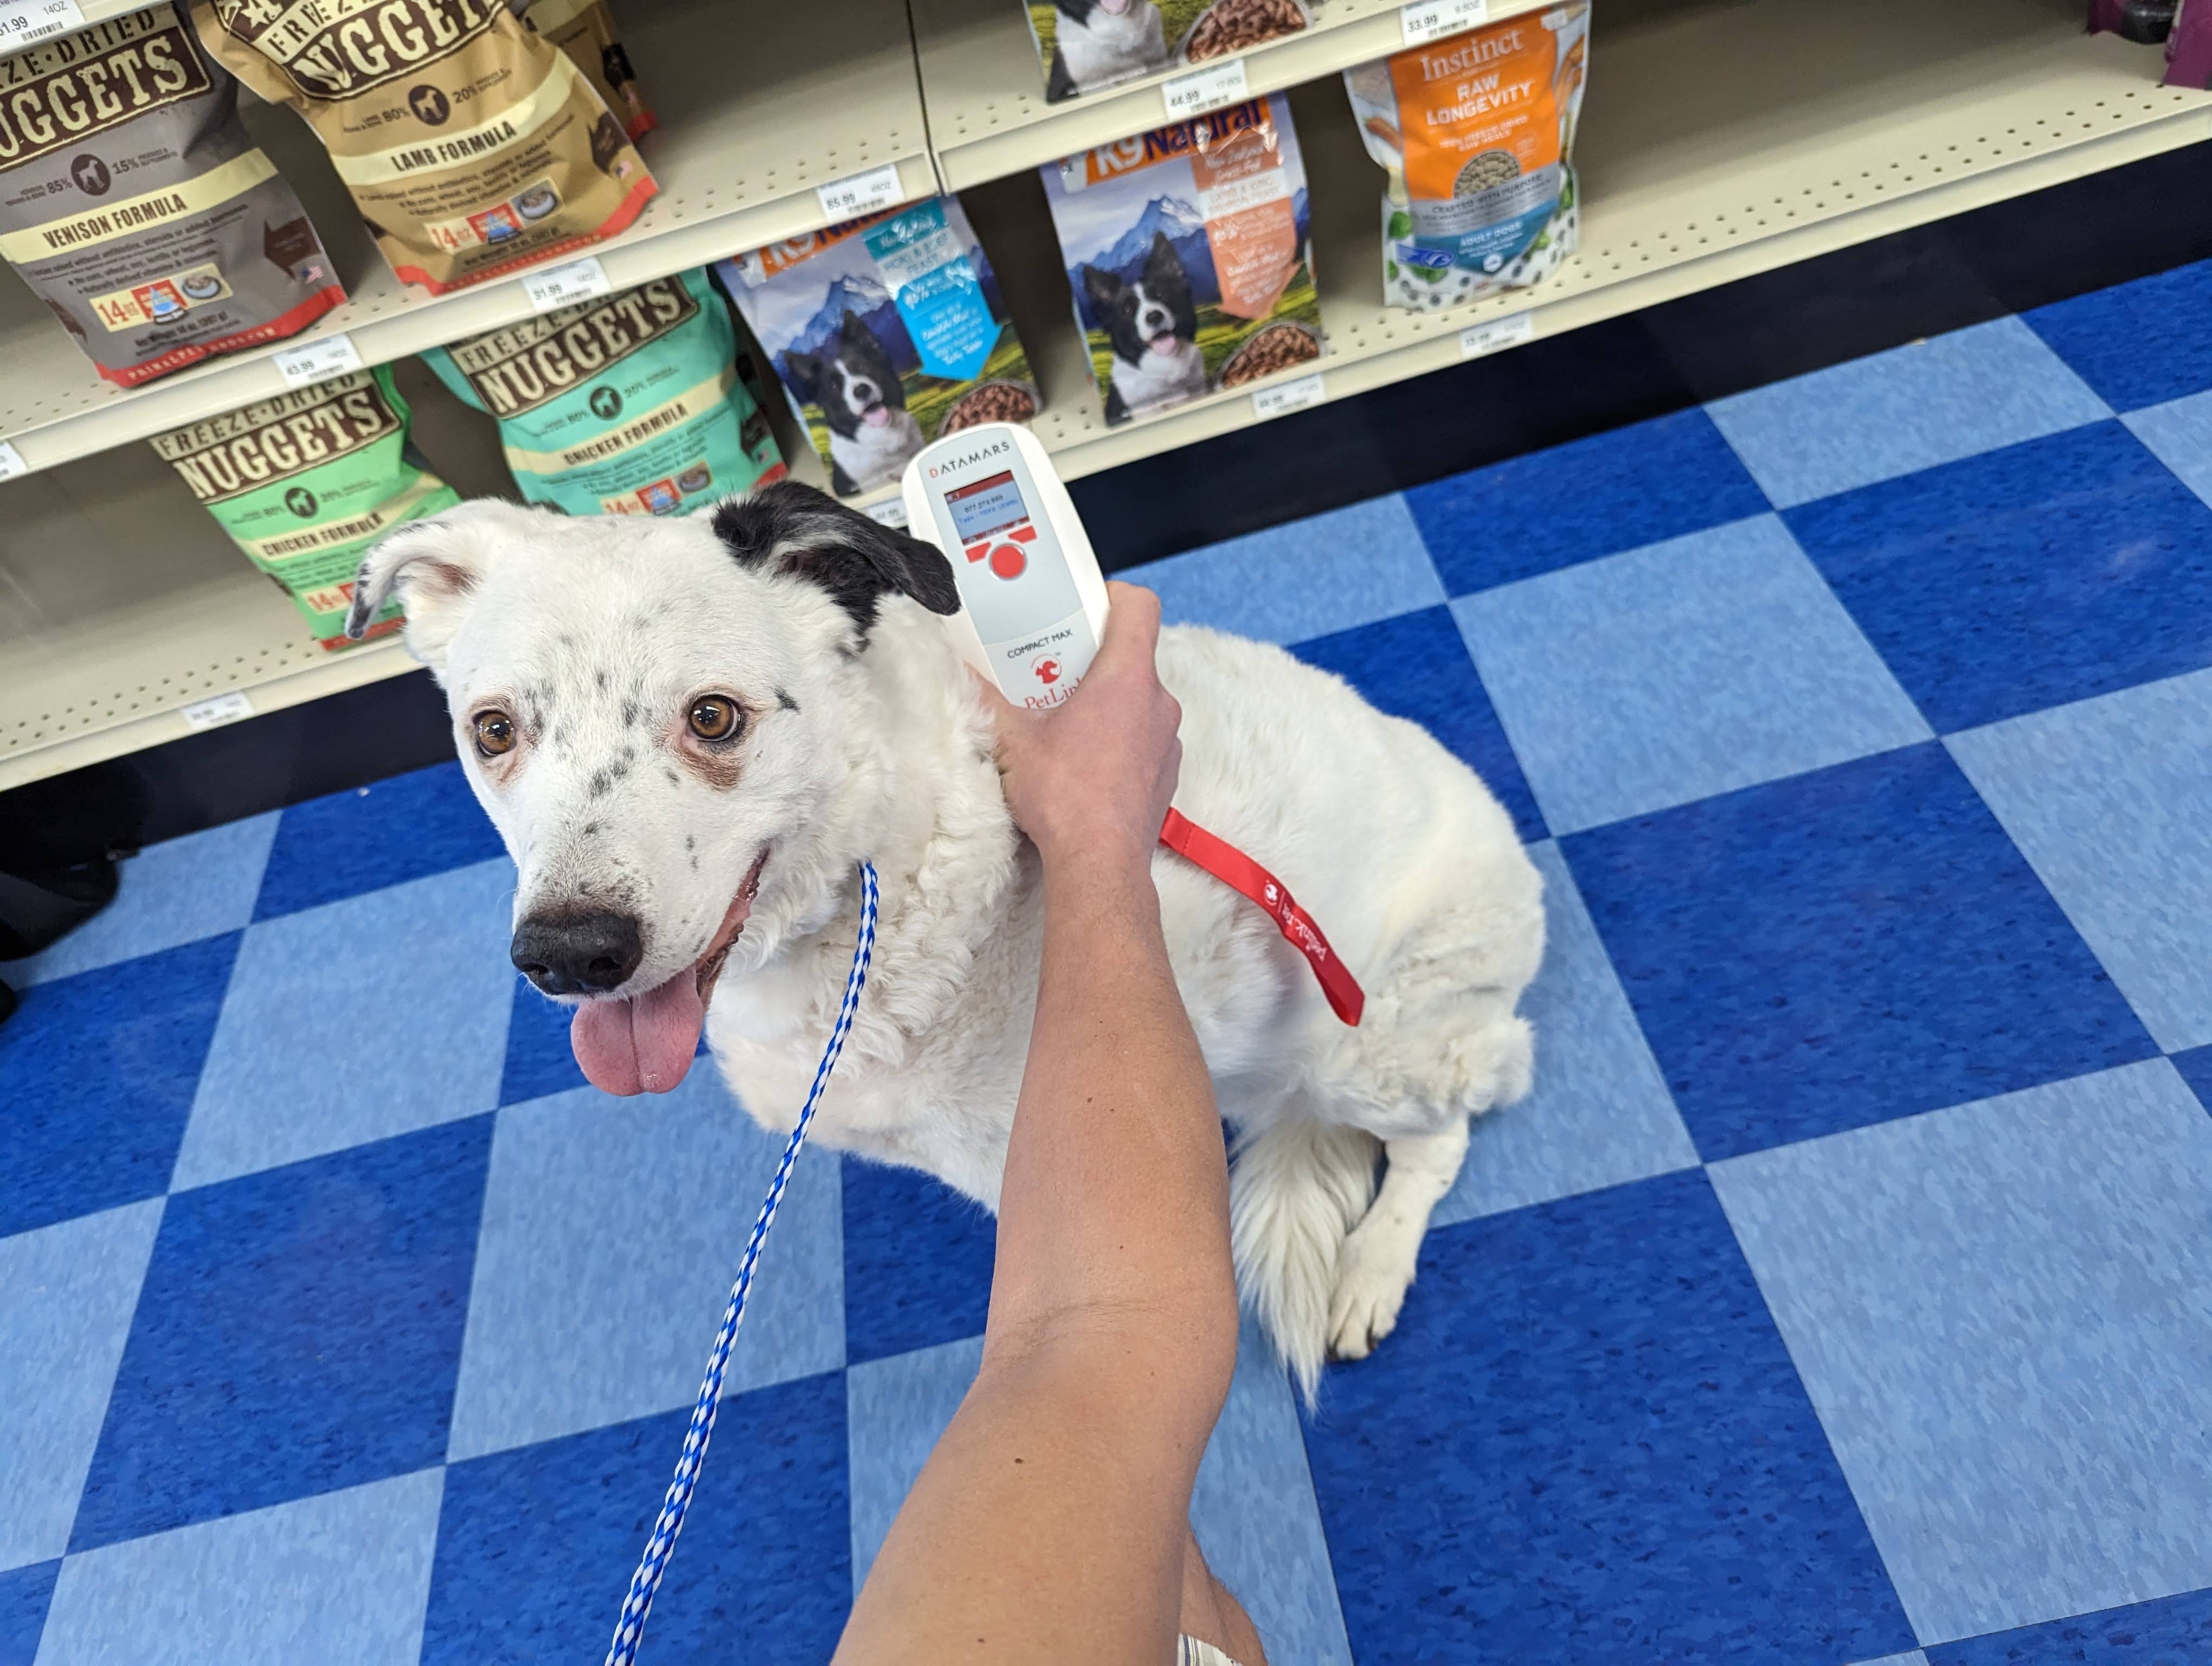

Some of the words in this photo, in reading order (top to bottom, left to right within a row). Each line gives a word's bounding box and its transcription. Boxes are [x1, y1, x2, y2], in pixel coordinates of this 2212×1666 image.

[1420, 28, 1525, 82] Instinct
[1425, 78, 1536, 126] LONGEVITY
[1456, 71, 1500, 101] RAW
[390, 147, 438, 172] LAMB
[436, 120, 517, 162] FORMULA
[42, 215, 113, 249] VENISON
[111, 193, 188, 229] FORMULA
[432, 227, 460, 248] 14
[99, 300, 130, 325] 14
[477, 278, 681, 414] NUGGETS
[173, 390, 383, 500] NUGGETS
[564, 434, 624, 465] CHICKEN
[623, 402, 689, 444] FORMULA
[929, 441, 1010, 479] DATAMARS
[262, 533, 319, 556] CHICKEN
[319, 511, 385, 543] FORMULA
[1007, 636, 1050, 658] COMPACT
[1051, 628, 1073, 642] MAX
